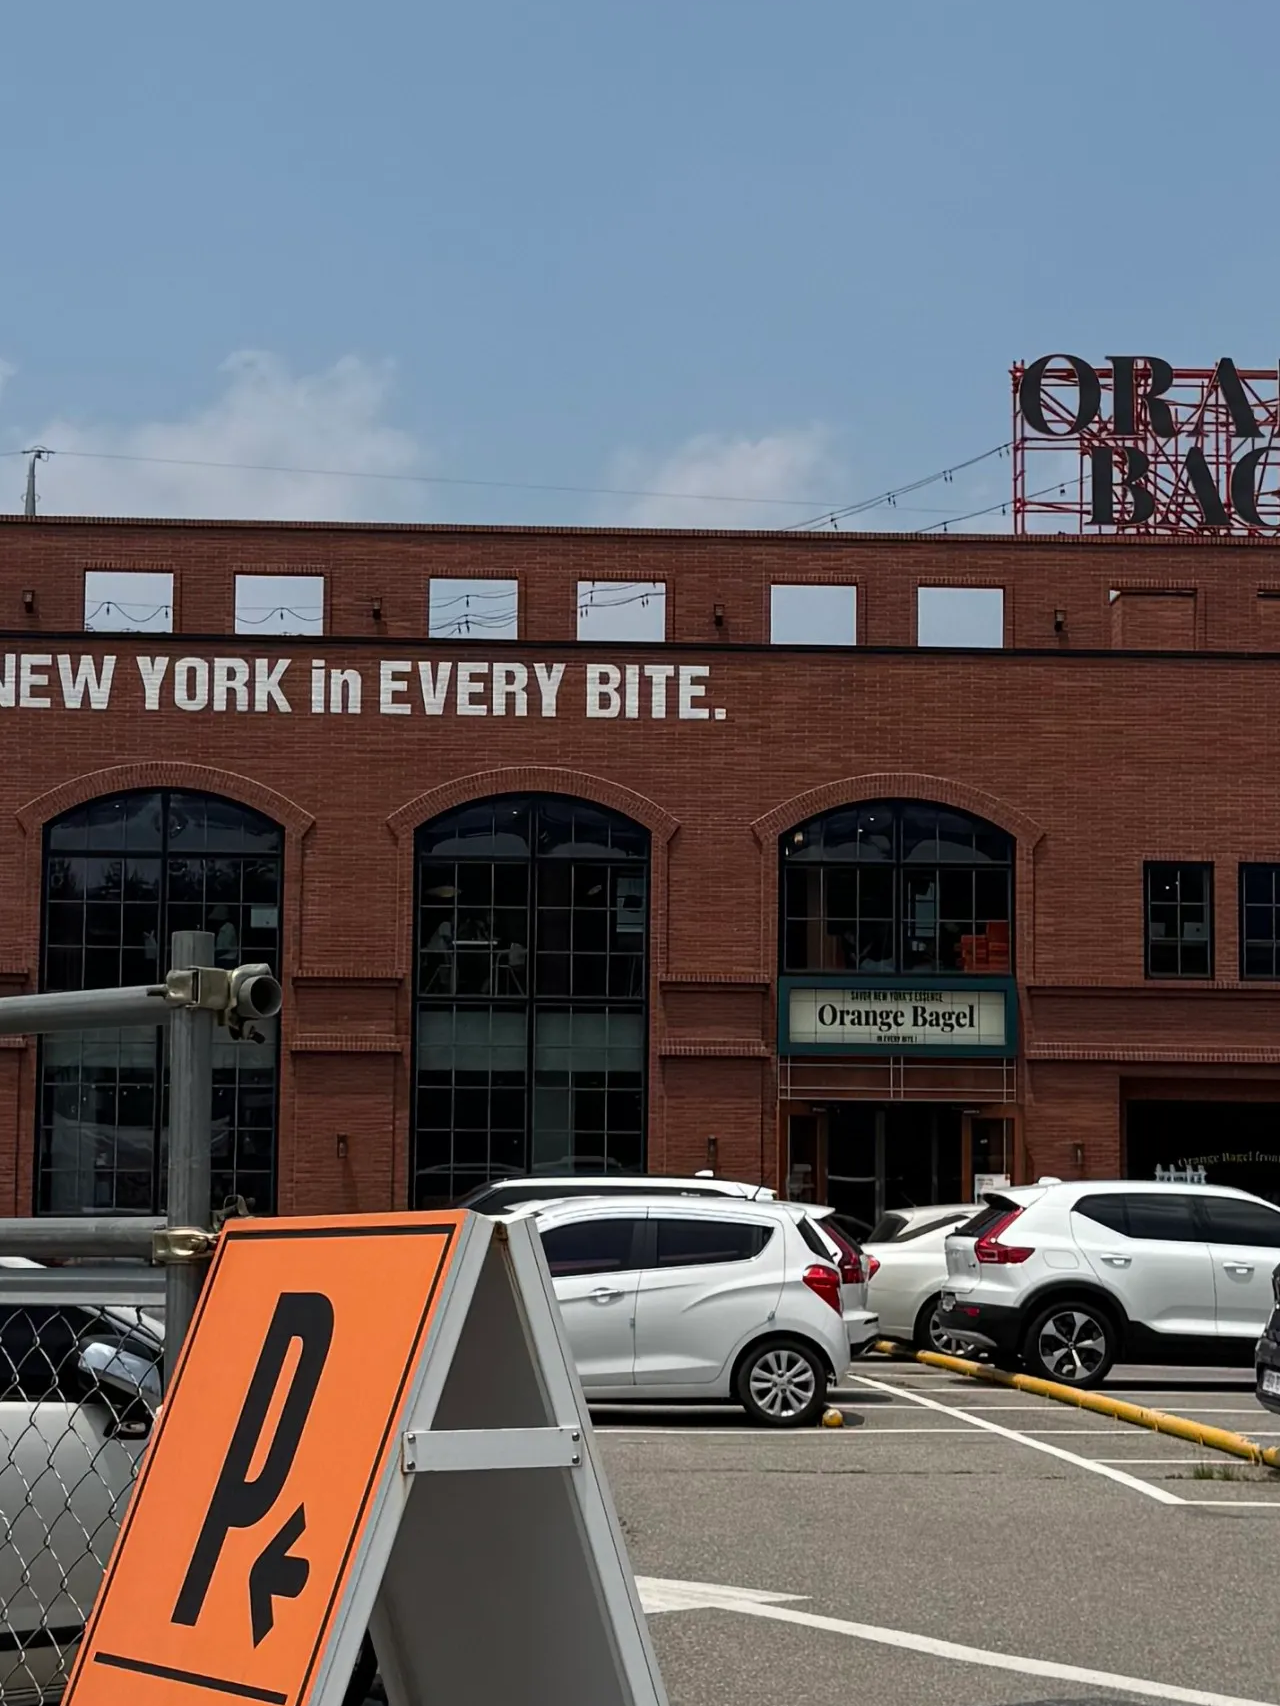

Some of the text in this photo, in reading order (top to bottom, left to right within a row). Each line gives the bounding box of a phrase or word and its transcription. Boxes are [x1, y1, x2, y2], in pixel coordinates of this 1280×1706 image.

[136, 656, 292, 713] YORK
[311, 659, 362, 715] in
[380, 660, 566, 718] EVERY
[586, 664, 727, 721] BITE.
[818, 1003, 975, 1033] Orange Bagel
